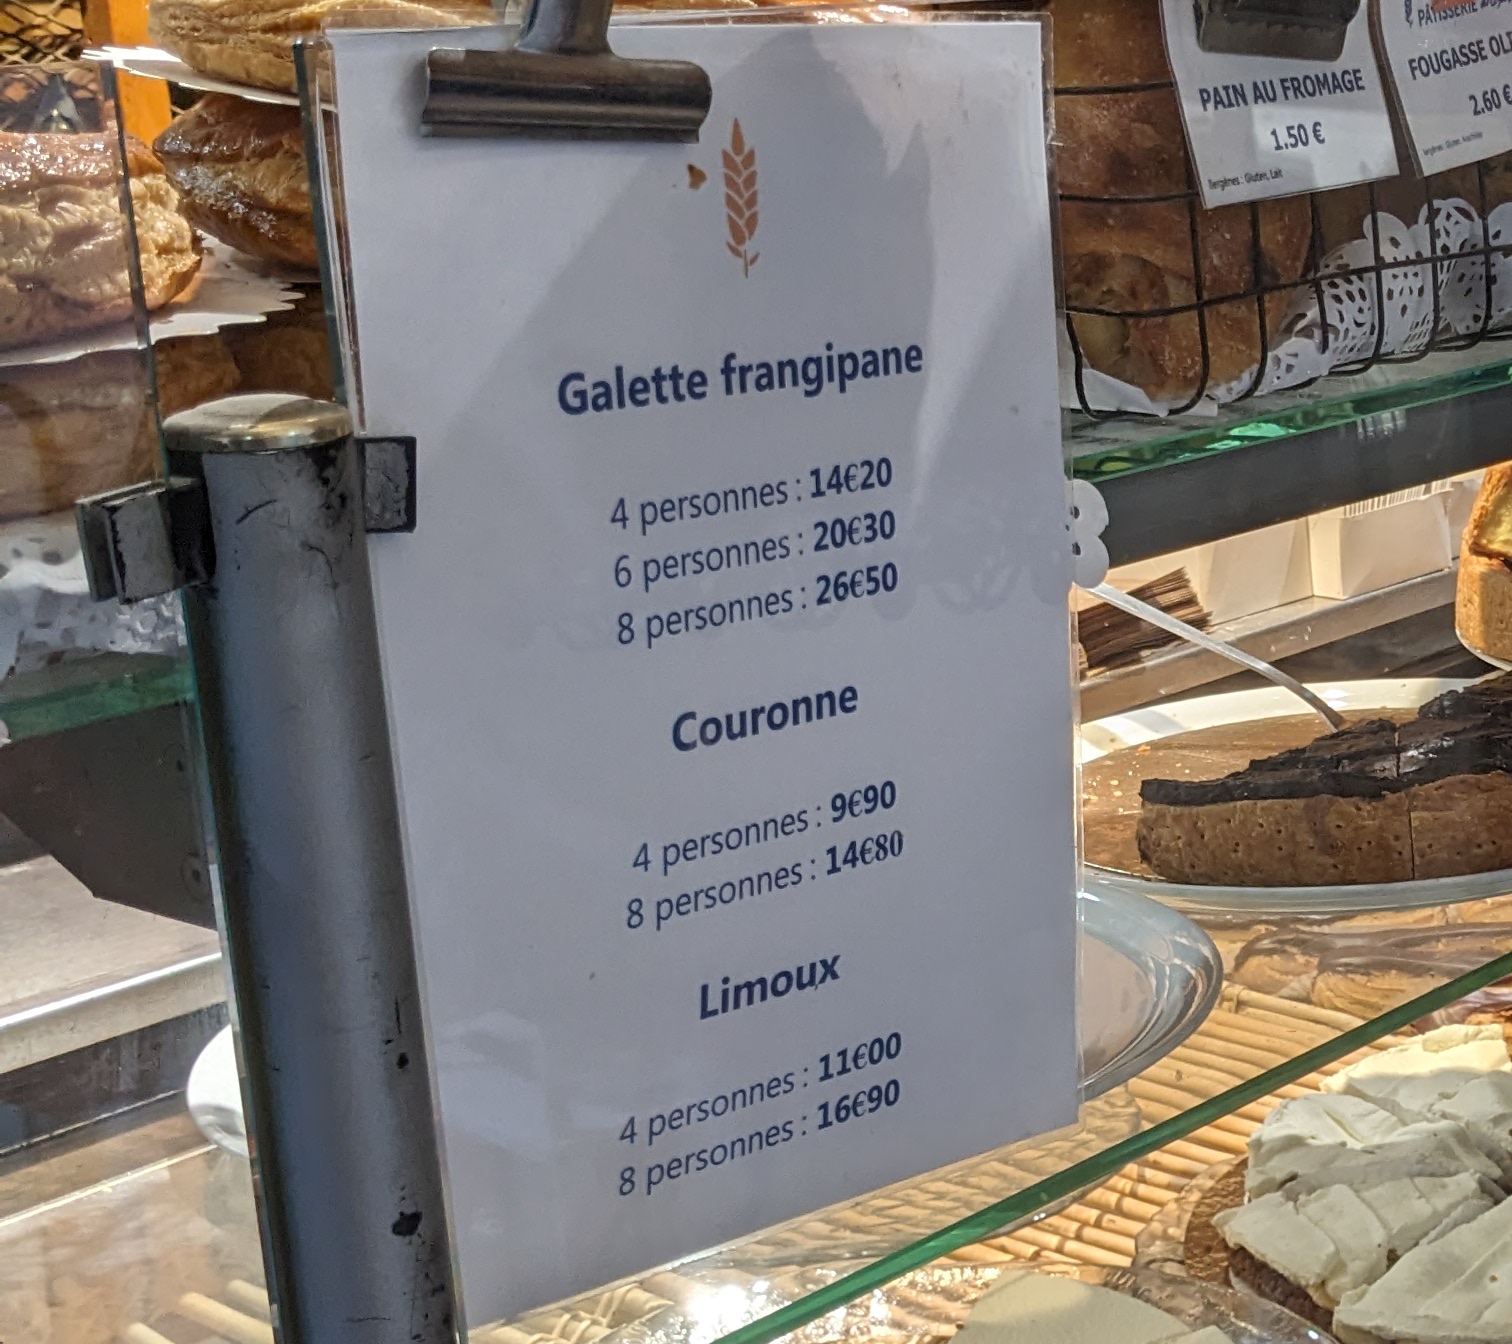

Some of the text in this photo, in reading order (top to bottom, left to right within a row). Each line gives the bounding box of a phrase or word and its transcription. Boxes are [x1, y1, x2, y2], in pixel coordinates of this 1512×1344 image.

[1198, 68, 1366, 112] PAIN AU FROMAGE
[1408, 40, 1488, 80] FOUGASSE
[1270, 121, 1326, 152] 1.50 €
[1468, 88, 1501, 118] 2.60
[557, 342, 925, 416] Galette frangipane
[610, 497, 629, 530] 4
[639, 478, 789, 536] personnes
[809, 456, 893, 499] 14€20
[614, 554, 632, 588] 6
[643, 533, 791, 593] personnes
[813, 509, 896, 552] 20€30
[617, 612, 635, 645] 8
[646, 588, 794, 649] personnes
[816, 562, 899, 605] 26€50
[671, 684, 859, 753] Couronne
[632, 843, 651, 873] 4
[662, 807, 809, 876] personnes
[830, 780, 897, 824] 9€90
[626, 898, 644, 930] 8
[655, 861, 803, 931] personnes
[825, 829, 904, 876] 14€80
[699, 953, 841, 1020] Limoux
[619, 1116, 637, 1145] 4
[647, 1071, 796, 1146] personnes
[818, 1031, 902, 1082] 11€00
[618, 1166, 636, 1197] 8
[646, 1117, 794, 1195] personnes
[817, 1078, 900, 1130] 16€90
